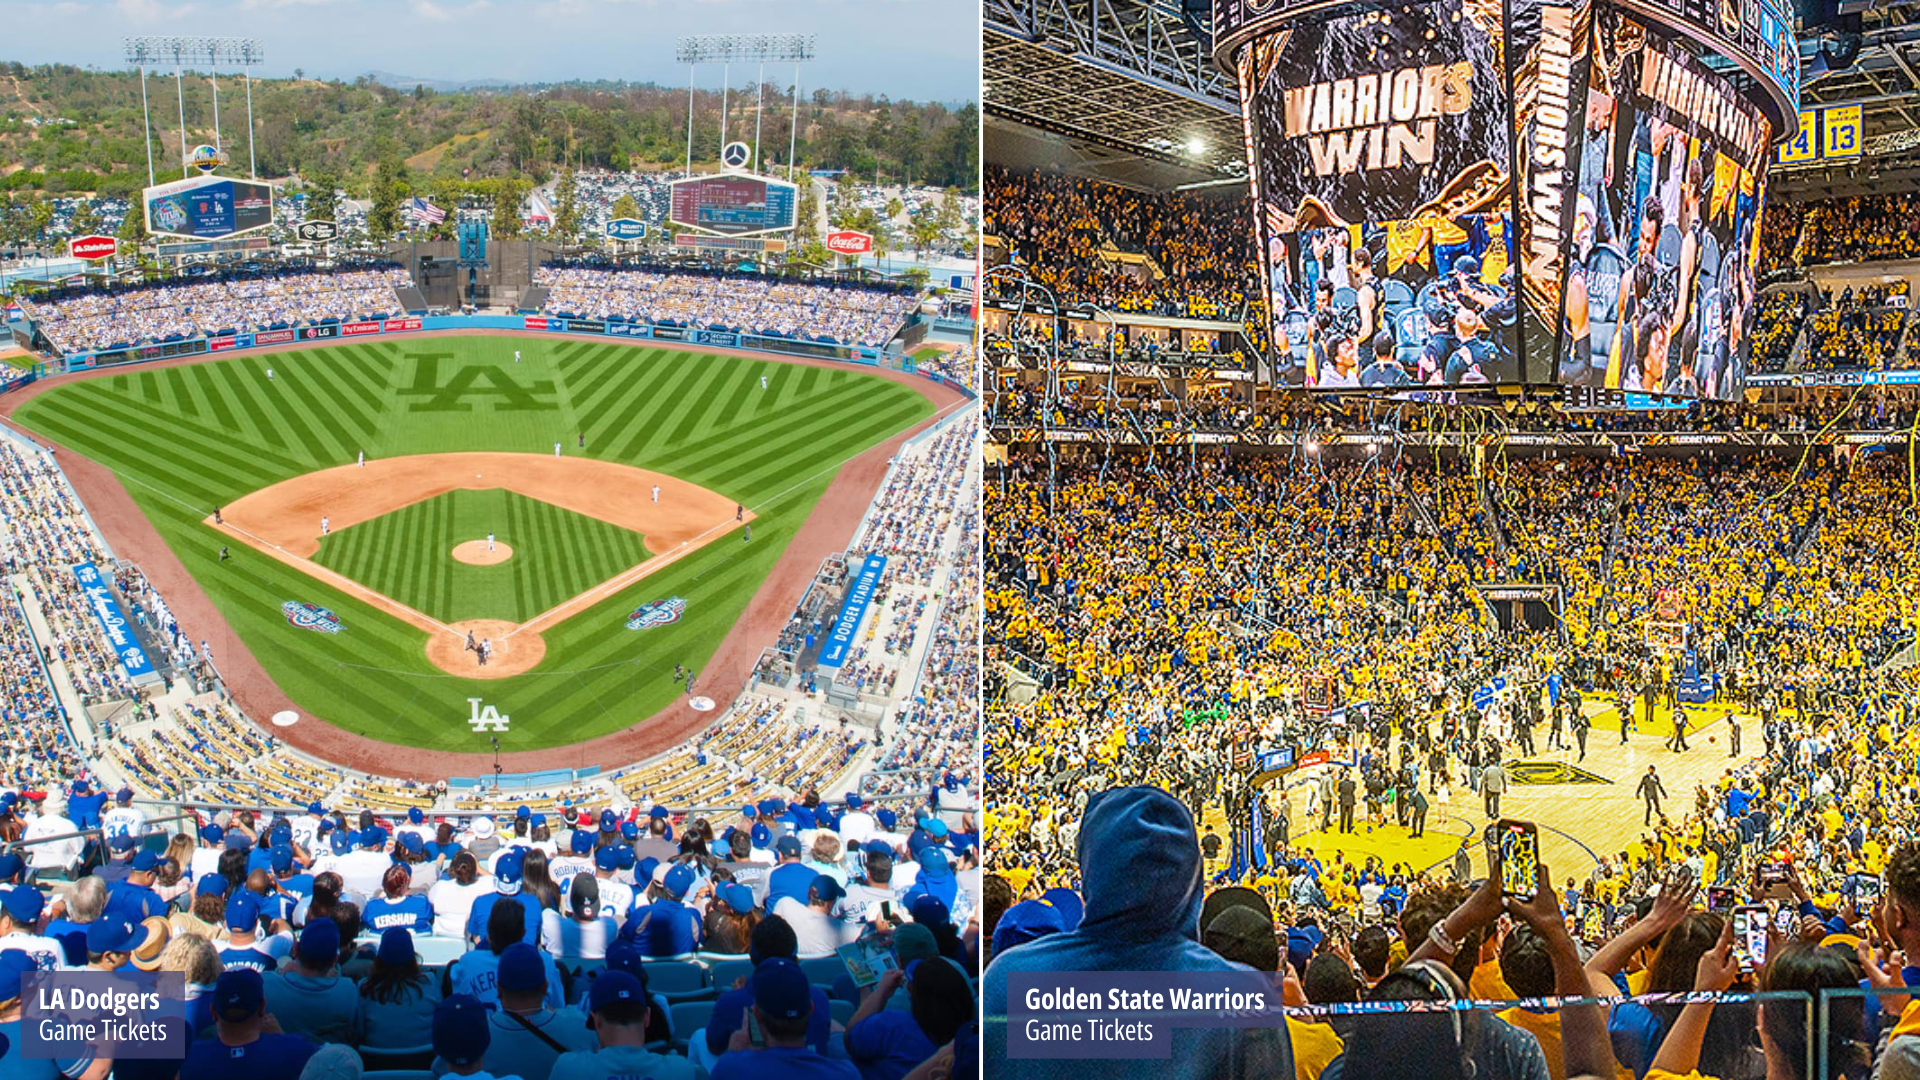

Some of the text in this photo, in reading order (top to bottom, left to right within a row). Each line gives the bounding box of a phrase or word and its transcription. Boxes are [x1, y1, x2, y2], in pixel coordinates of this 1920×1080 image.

[1284, 61, 1474, 140] WARRIORS
[1308, 119, 1437, 177] WIN
[1527, 6, 1573, 283] WARRIORS WIN
[1786, 129, 1809, 156] 14
[1830, 124, 1855, 151] 13
[318, 327, 330, 337] LG
[396, 353, 559, 412] LA
[834, 606, 860, 642] DODGER
[852, 571, 876, 604] STADIUM
[467, 698, 510, 732] LA
[107, 824, 129, 839] 34
[374, 912, 417, 929] KERSHAW
